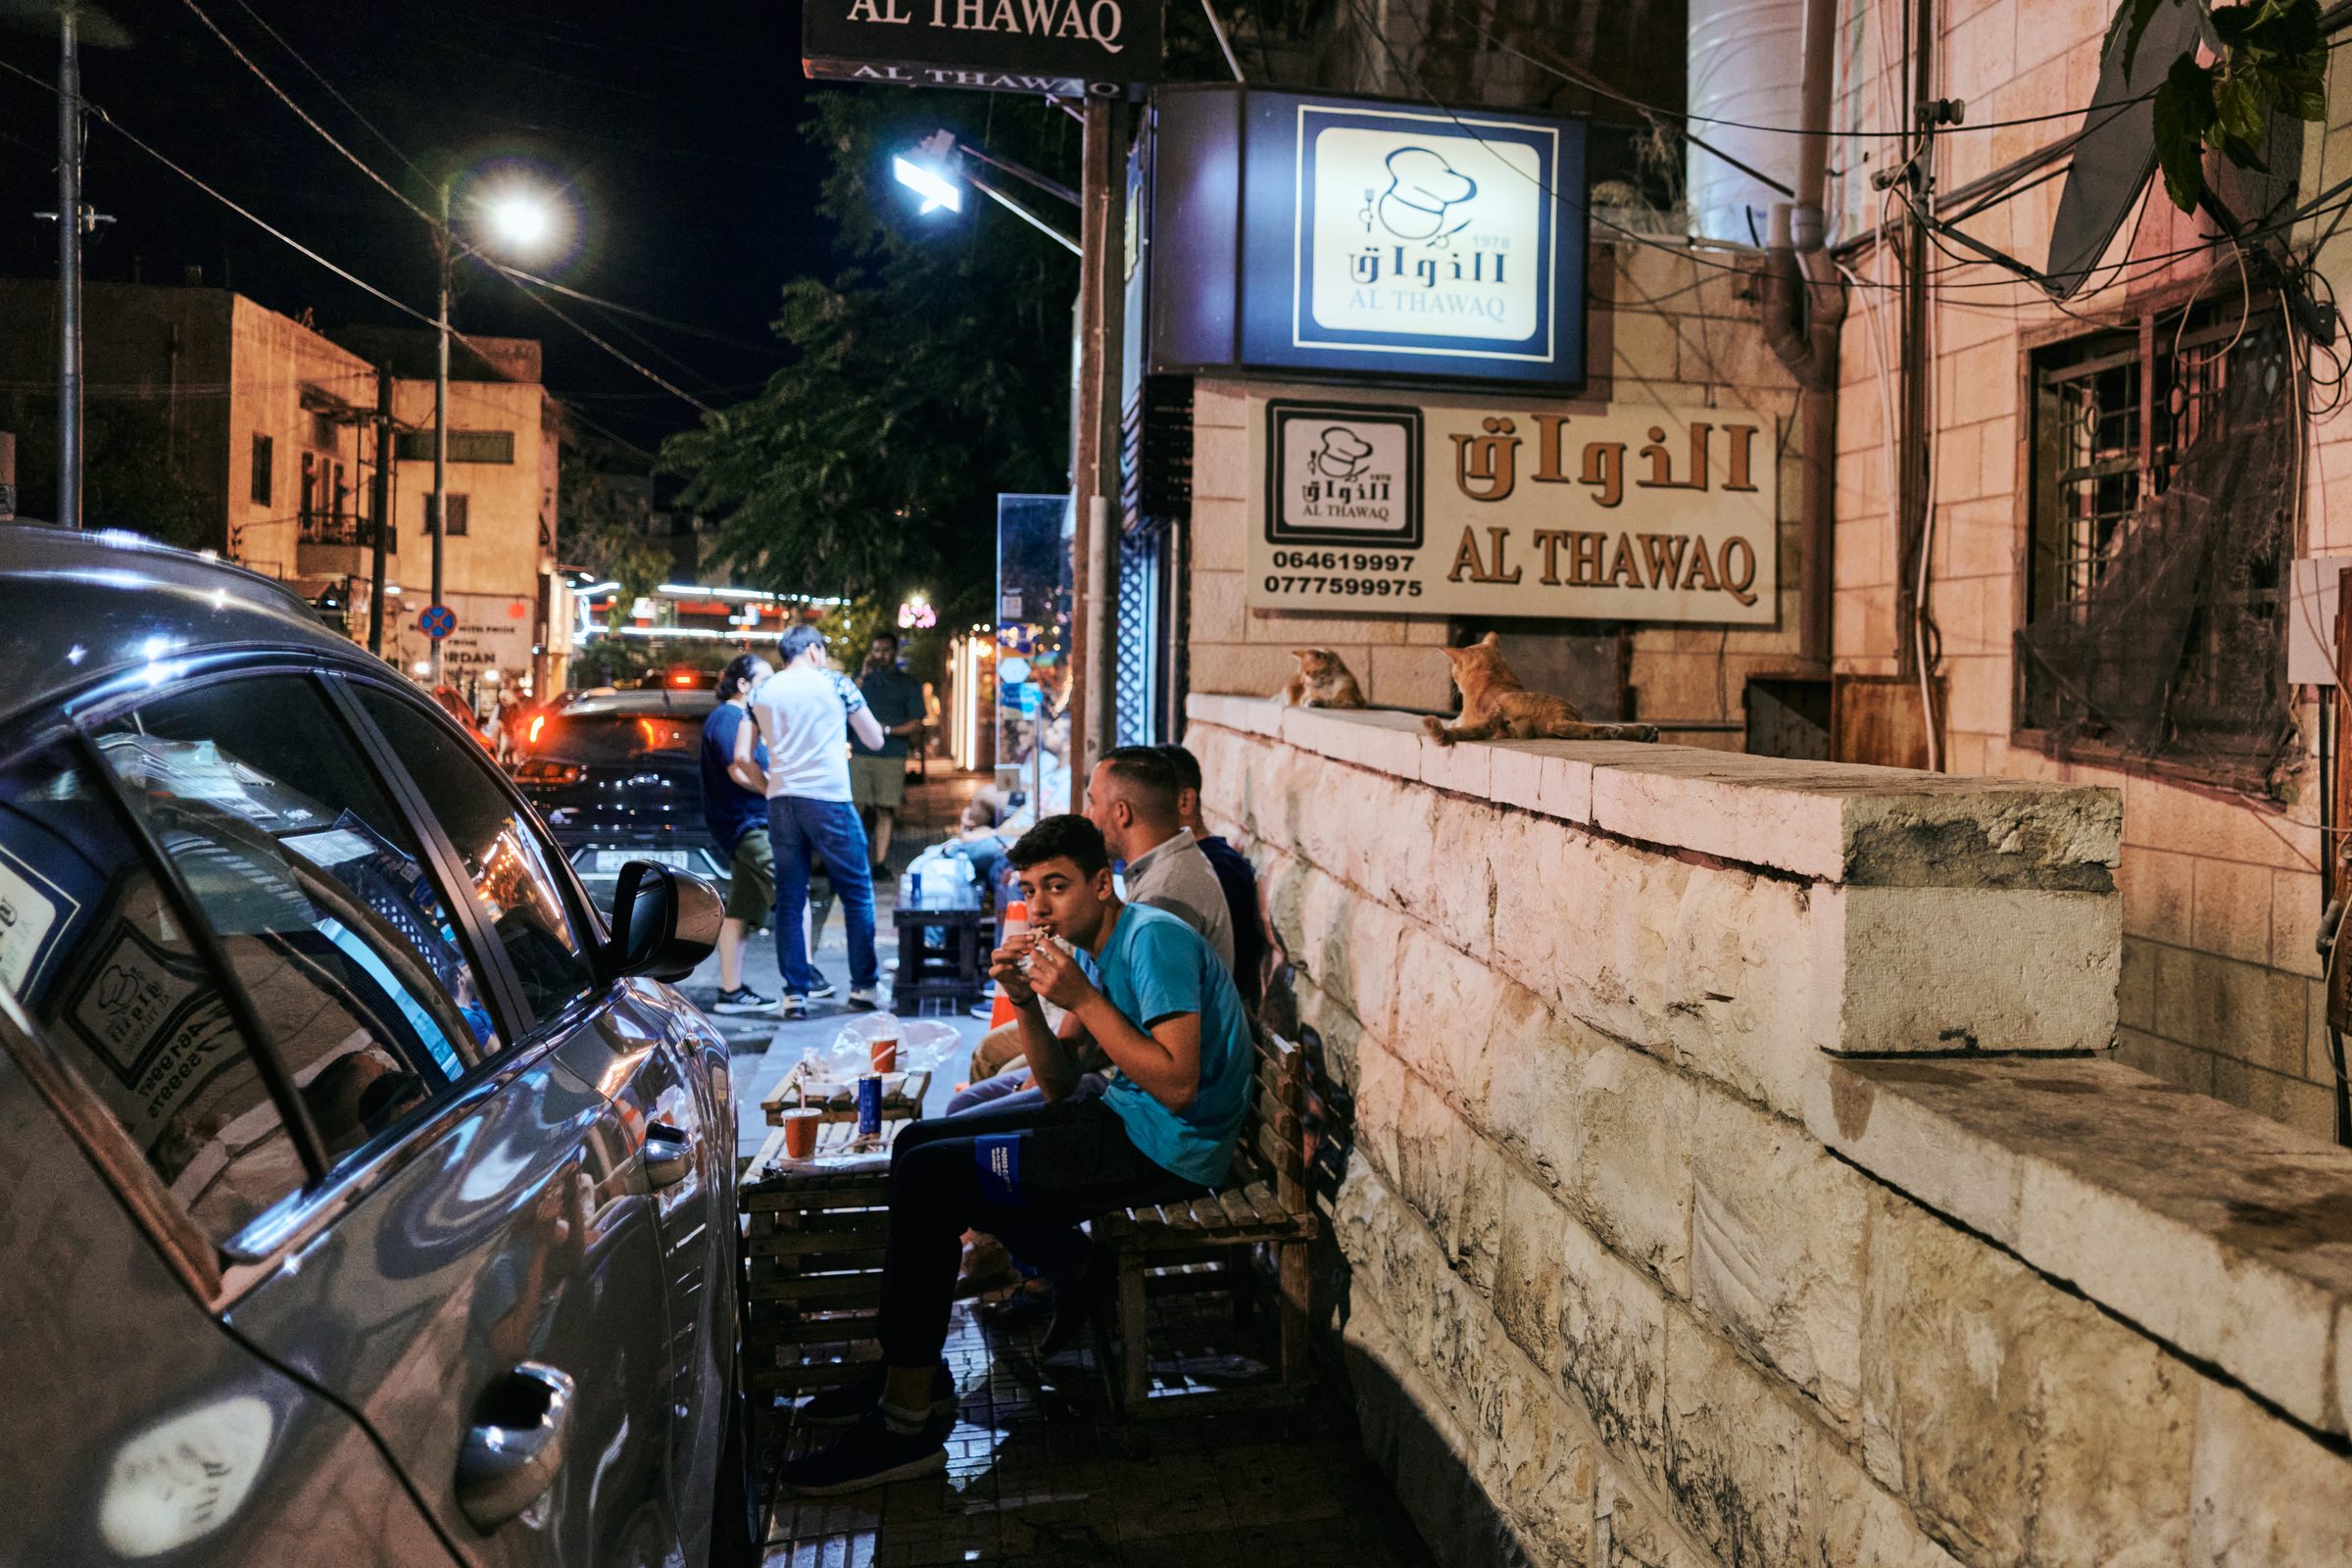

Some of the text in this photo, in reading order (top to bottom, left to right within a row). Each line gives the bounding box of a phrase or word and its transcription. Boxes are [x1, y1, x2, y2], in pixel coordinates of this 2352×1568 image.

[853, 65, 1120, 95] AL THAWAQ
[1348, 245, 1511, 289] الذواق
[1348, 288, 1506, 323] AL THAWAQ
[1448, 414, 1759, 509] الذواق
[1301, 480, 1391, 504] الذواق
[1302, 504, 1390, 523] AL THAWAQ
[1273, 551, 1415, 572] 064619997
[1447, 524, 1758, 608] AL THAWAQ
[1264, 575, 1423, 598] 0777599975
